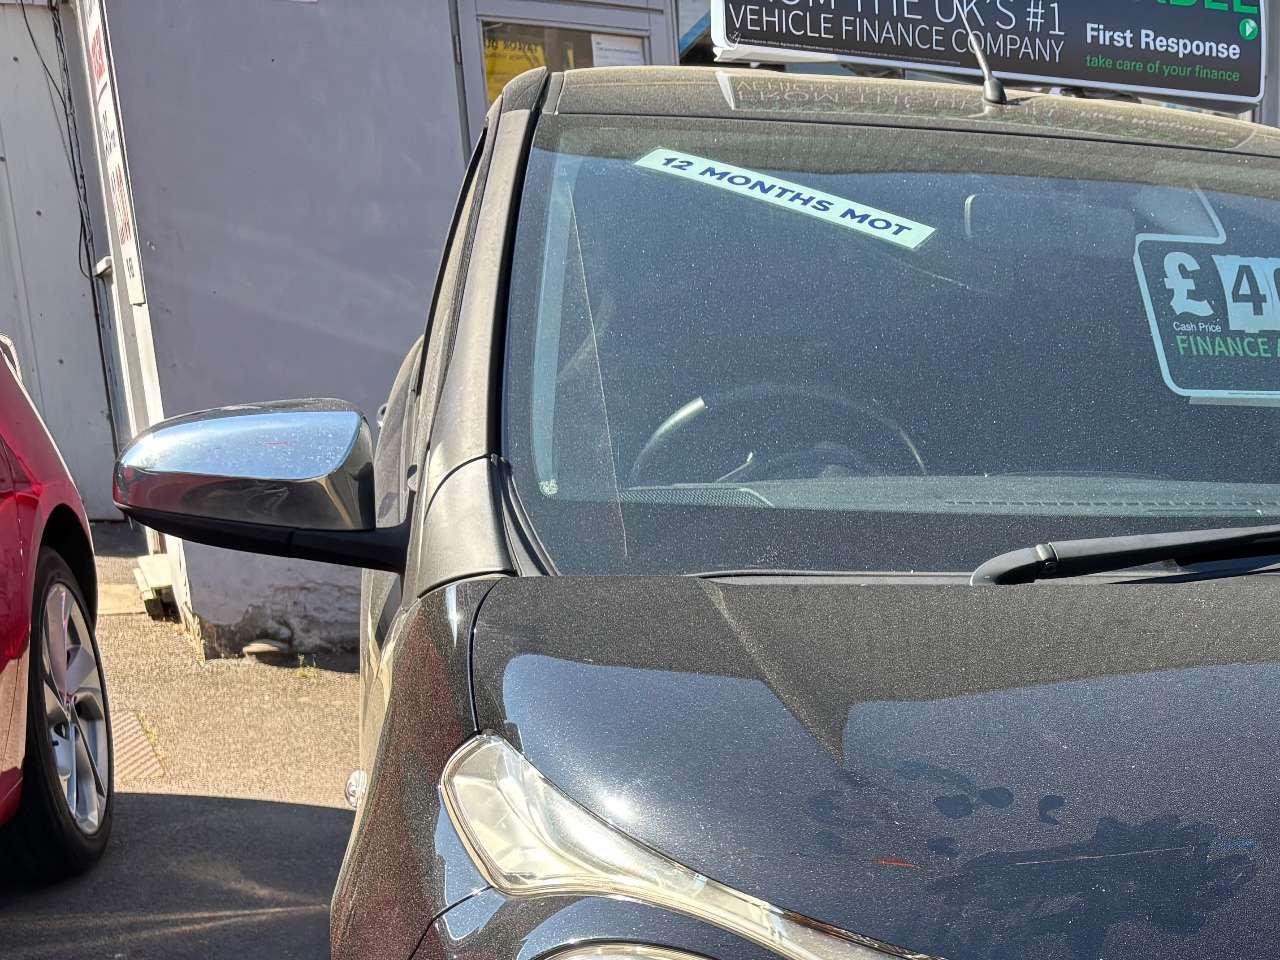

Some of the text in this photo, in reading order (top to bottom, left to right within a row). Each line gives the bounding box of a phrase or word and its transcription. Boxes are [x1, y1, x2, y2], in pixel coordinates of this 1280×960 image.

[728, 4, 834, 39] VEHICLE
[842, 16, 945, 51] FINANCE
[952, 29, 1065, 63] COMPANY
[1026, 0, 1065, 35] #1
[1086, 22, 1240, 59] First Response
[1086, 54, 1240, 82] take care of your finance
[662, 156, 912, 236] 12 MONTHS MOT
[1173, 321, 1222, 333] Cash Price
[1176, 335, 1269, 357] FINANCE
